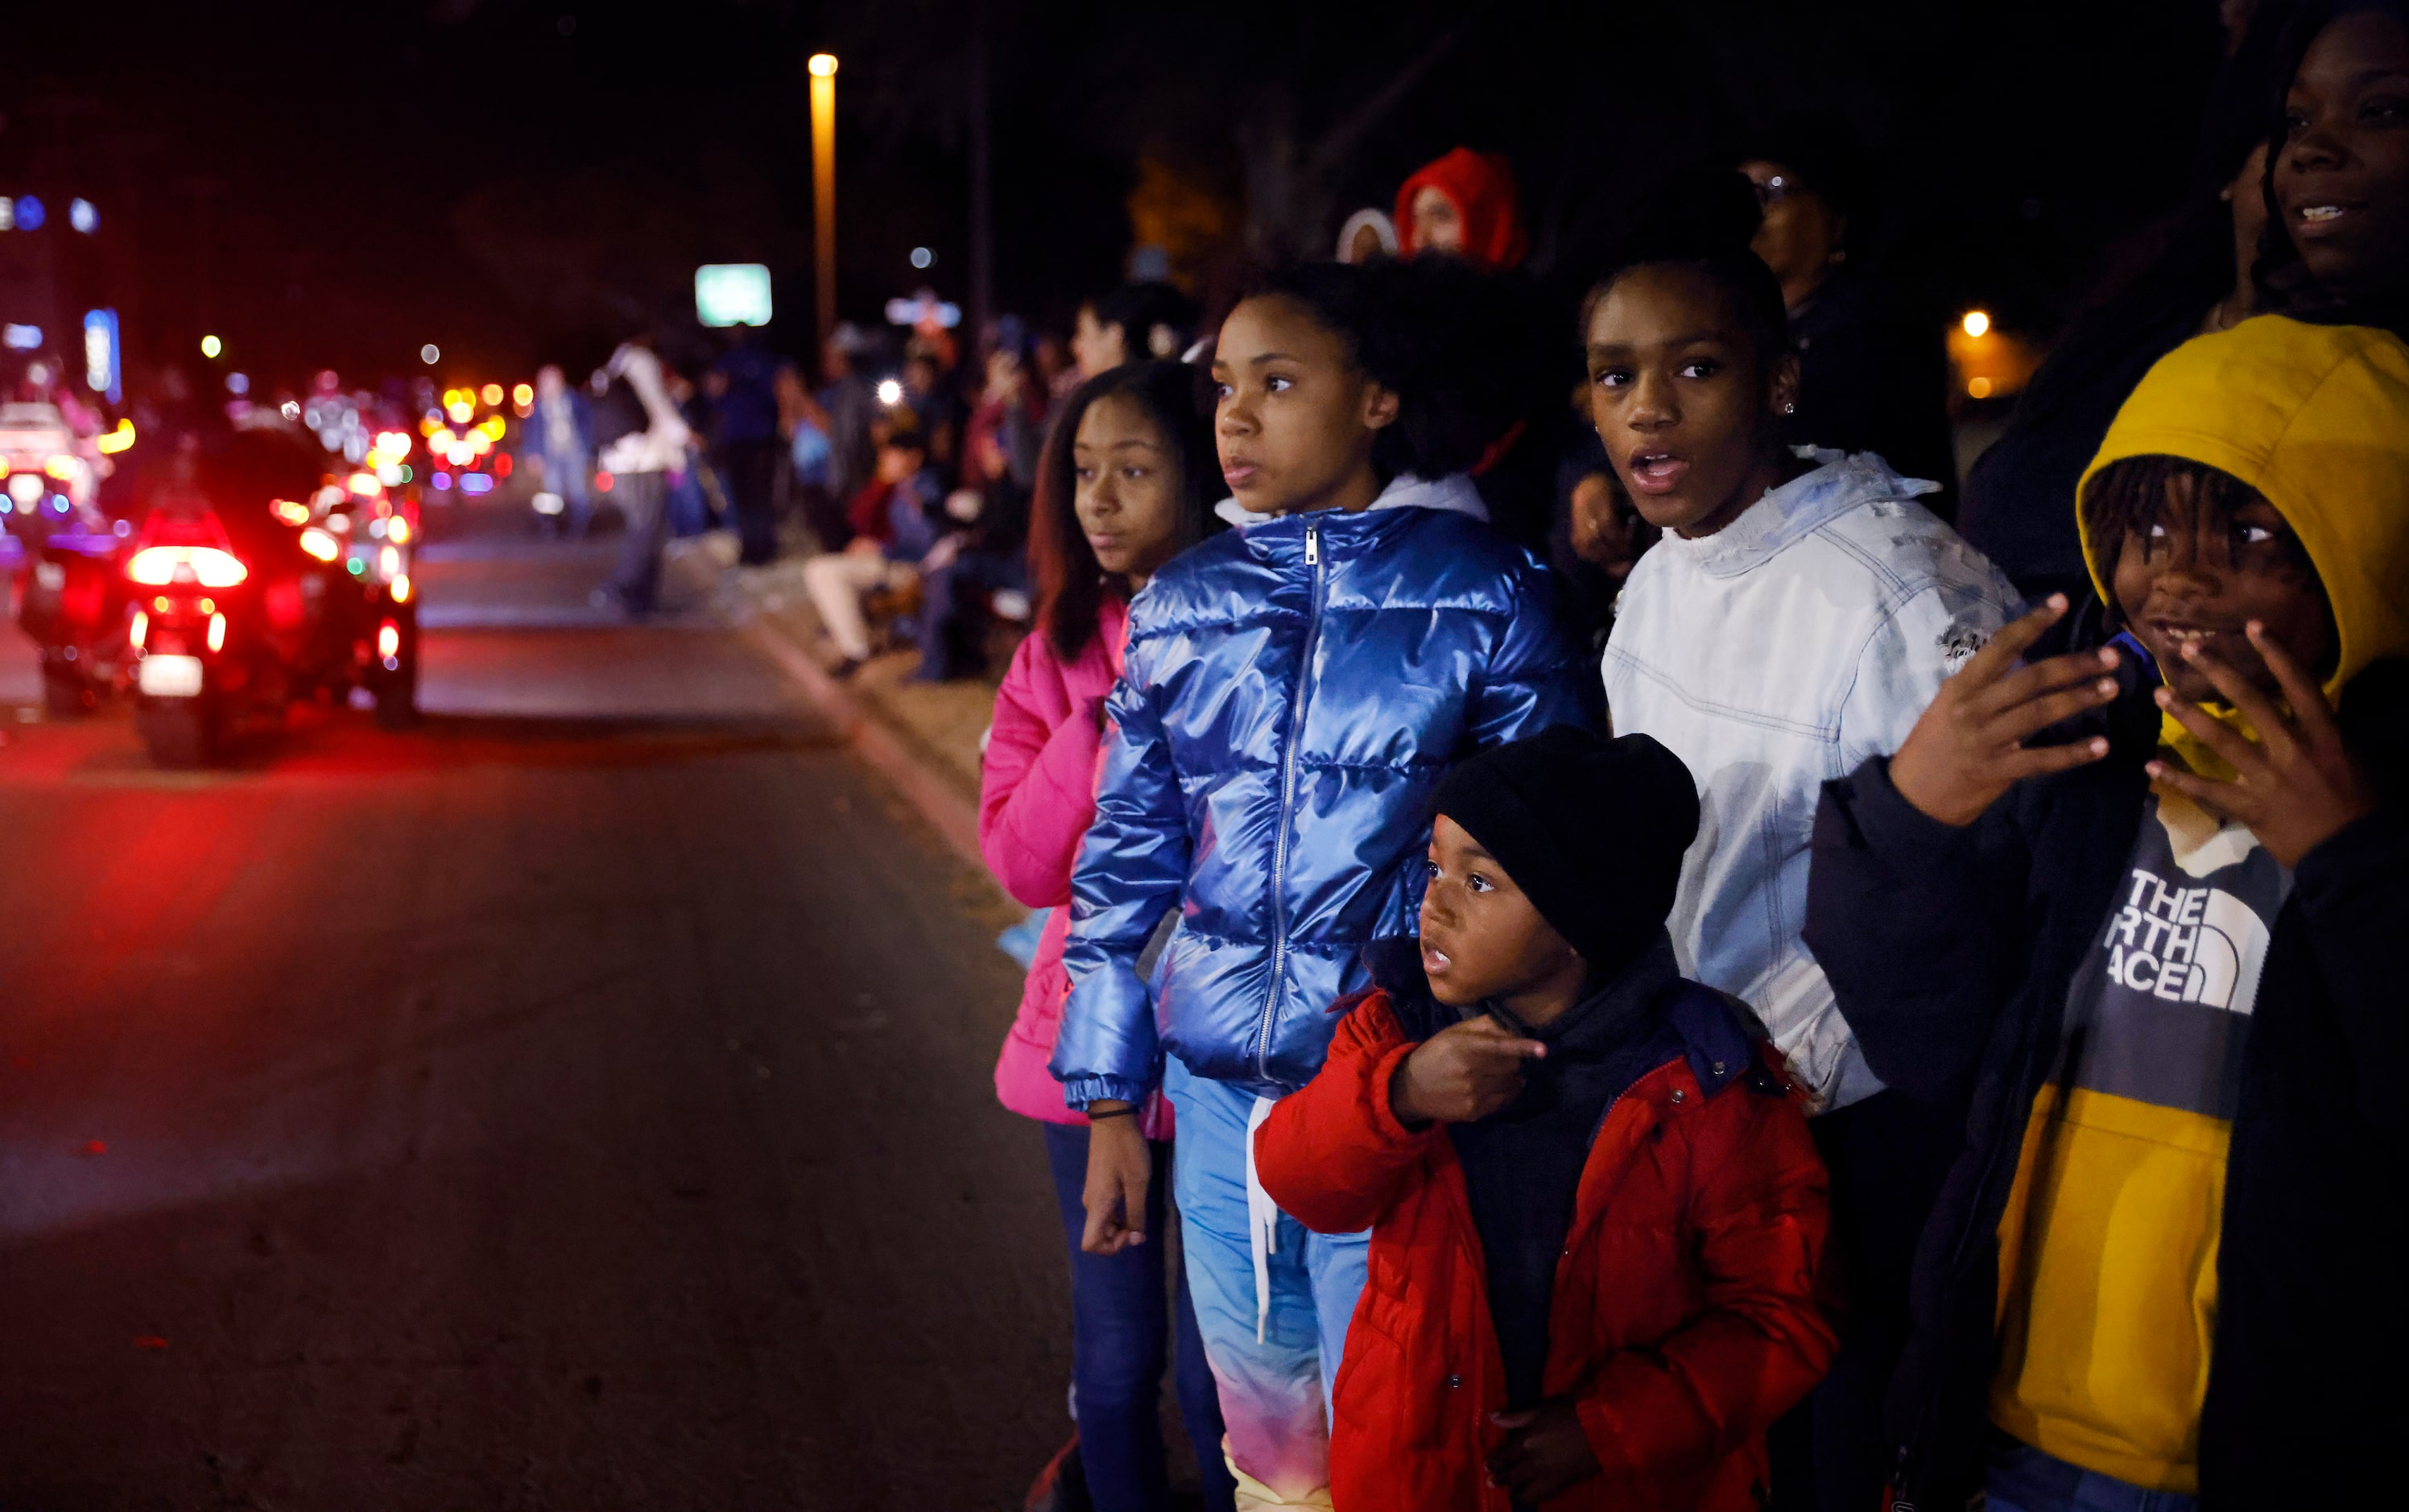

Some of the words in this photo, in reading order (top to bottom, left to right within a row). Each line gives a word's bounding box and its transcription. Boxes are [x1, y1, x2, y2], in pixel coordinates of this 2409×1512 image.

[2129, 869, 2209, 925] THE
[2104, 905, 2198, 964] RTH
[2107, 944, 2188, 1001] ACE
